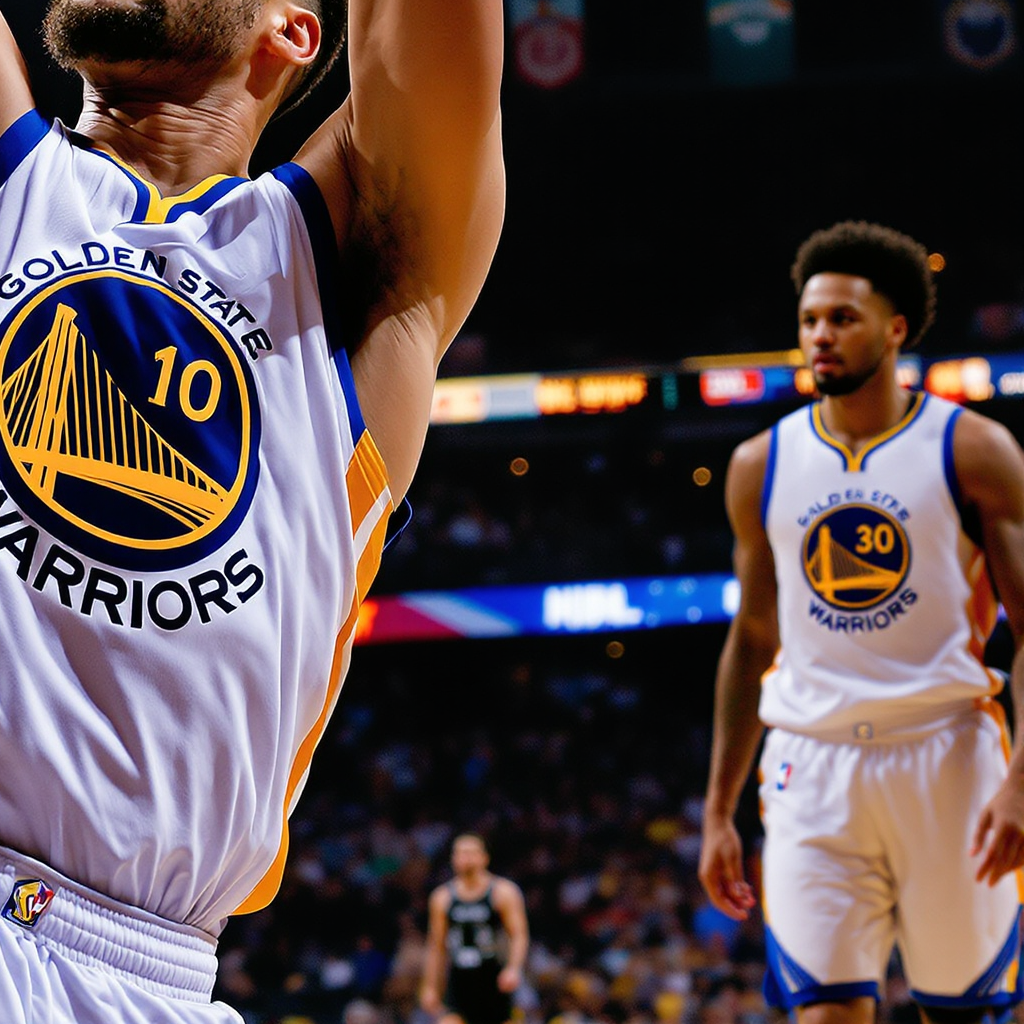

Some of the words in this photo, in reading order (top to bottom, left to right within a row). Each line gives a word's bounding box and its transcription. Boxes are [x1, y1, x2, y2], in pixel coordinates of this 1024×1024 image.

[176, 268, 274, 363] STATE
[148, 345, 222, 423] 10
[855, 522, 896, 555] 30
[809, 586, 919, 634] WARRIORS
